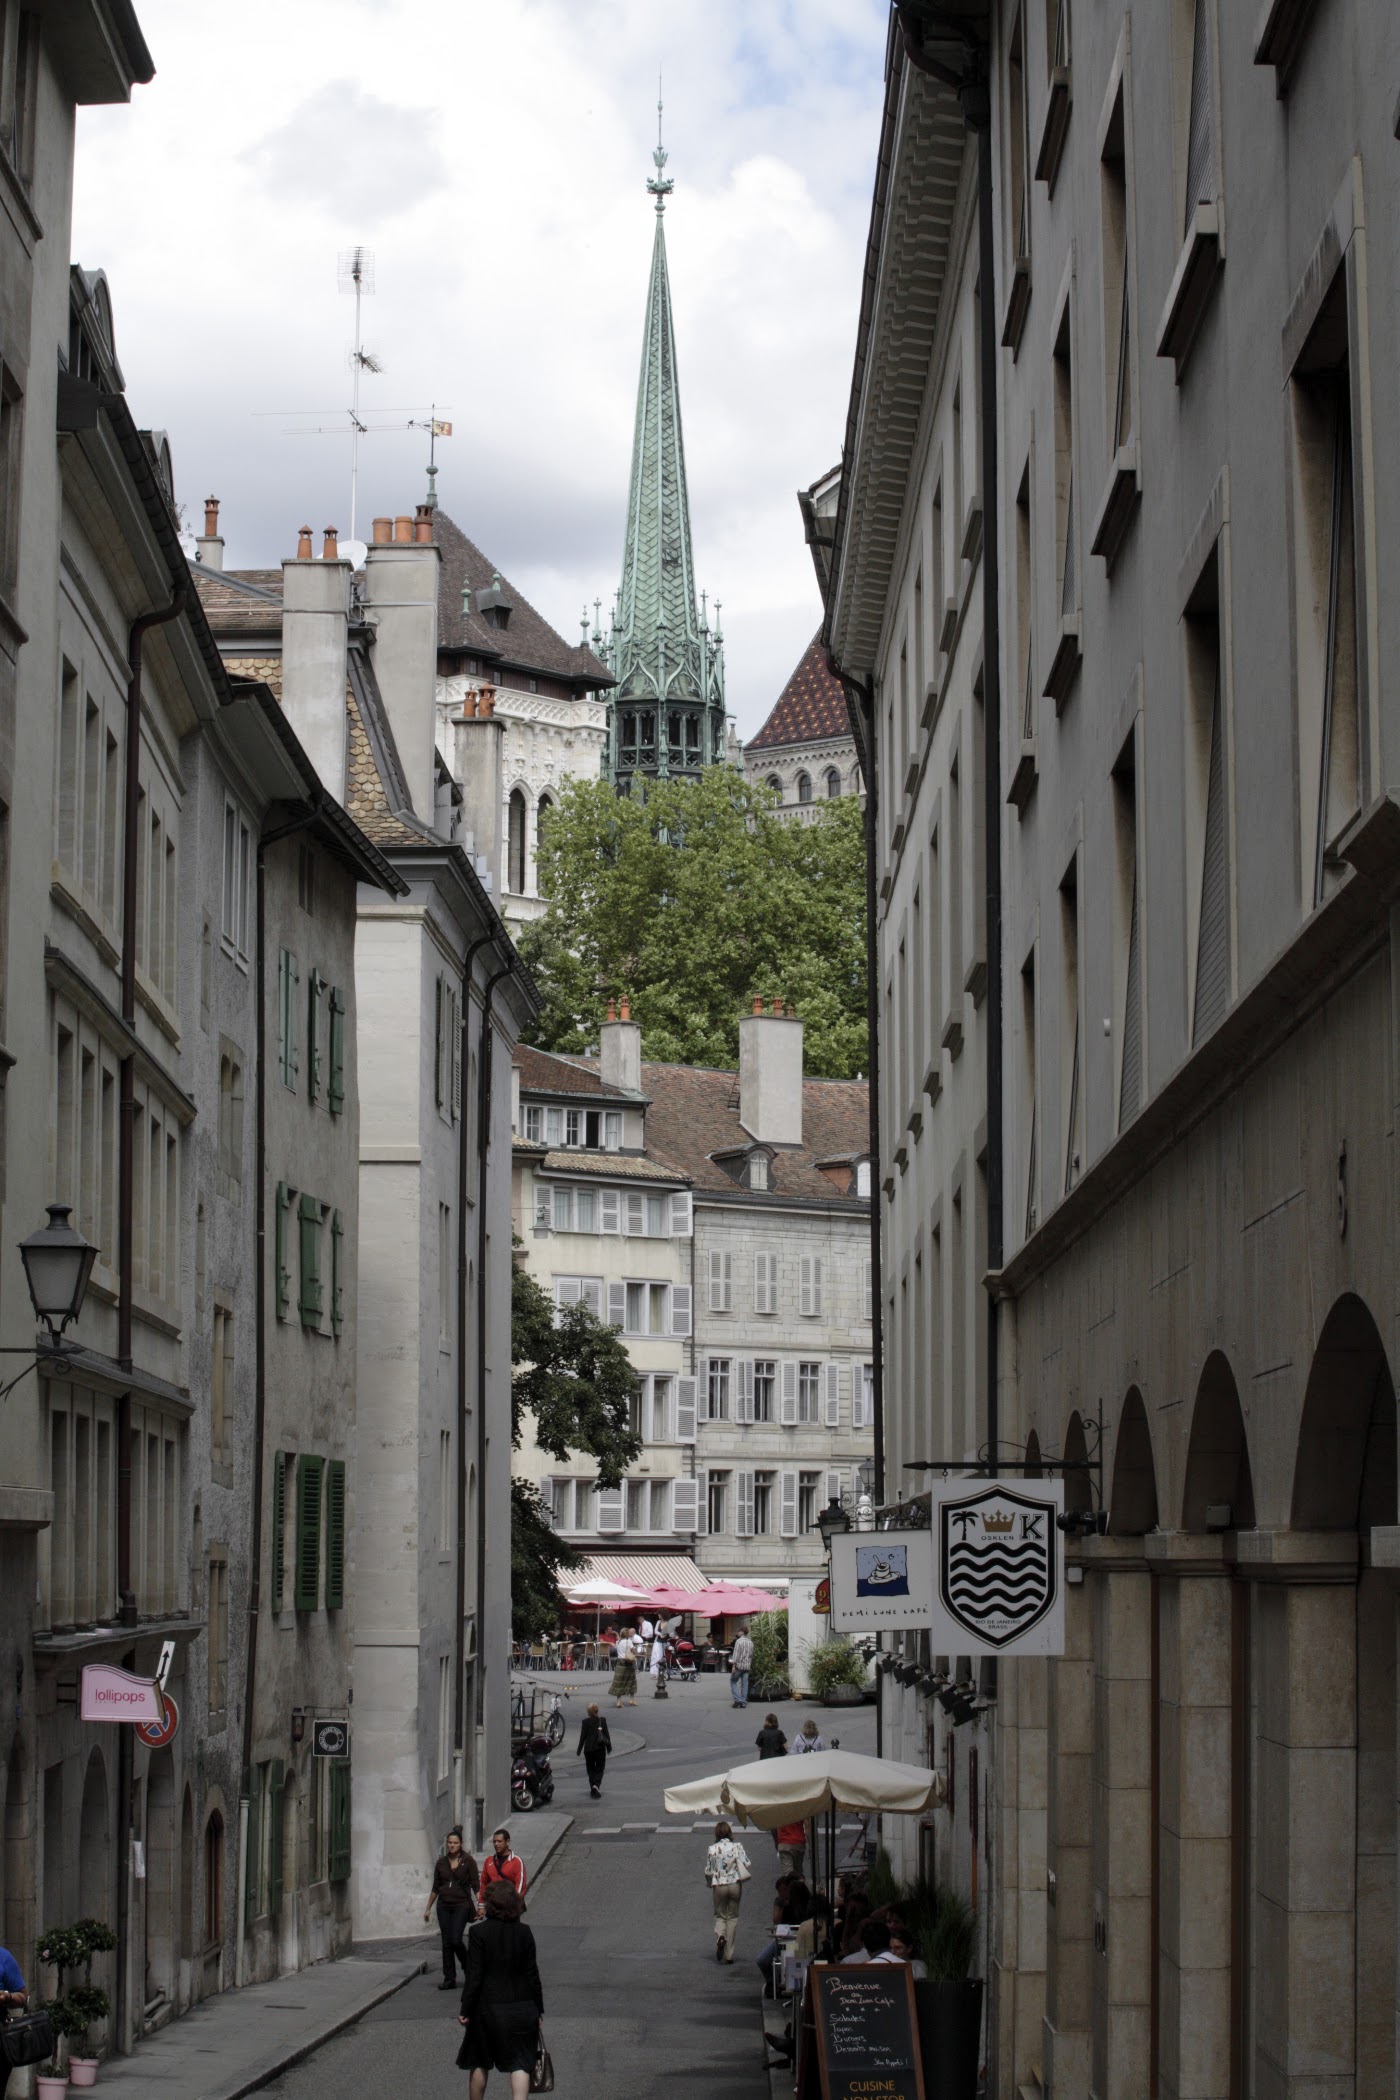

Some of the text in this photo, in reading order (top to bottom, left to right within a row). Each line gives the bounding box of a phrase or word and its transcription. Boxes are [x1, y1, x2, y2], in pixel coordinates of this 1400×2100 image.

[1020, 1514, 1044, 1540] K
[903, 1603, 928, 1614] CAFÉ
[95, 1688, 146, 1704] lollipops
[826, 1977, 881, 1995] Bienvenue
[829, 2013, 865, 2022] Salades
[830, 2033, 866, 2044] Burgers
[849, 2080, 896, 2092] CUISINE
